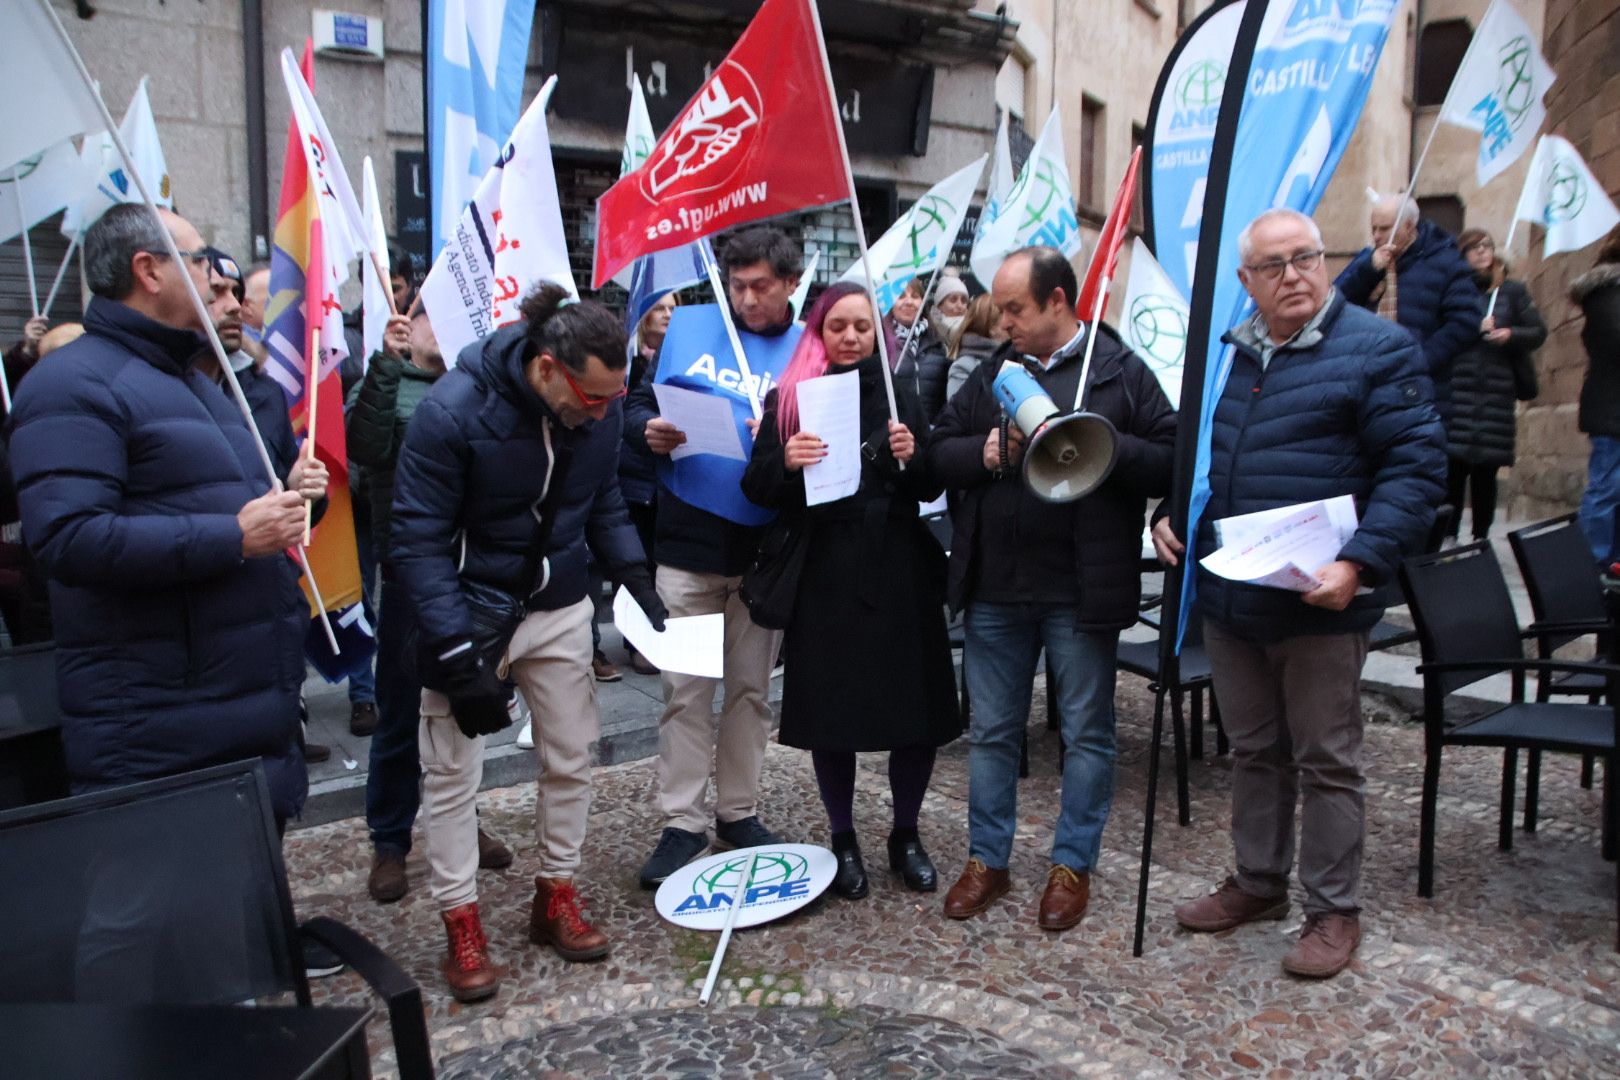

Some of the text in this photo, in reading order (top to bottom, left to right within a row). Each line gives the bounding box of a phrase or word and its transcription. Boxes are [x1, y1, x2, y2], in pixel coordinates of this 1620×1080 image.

[1251, 59, 1331, 97] CASTILL
[1169, 107, 1219, 131] ANP
[1156, 148, 1208, 170] CASTILLA
[456, 219, 480, 273] ndicato
[446, 250, 487, 338] Agencia Trib
[671, 906, 726, 917] SINDICATO
[673, 877, 811, 913] ANPE
